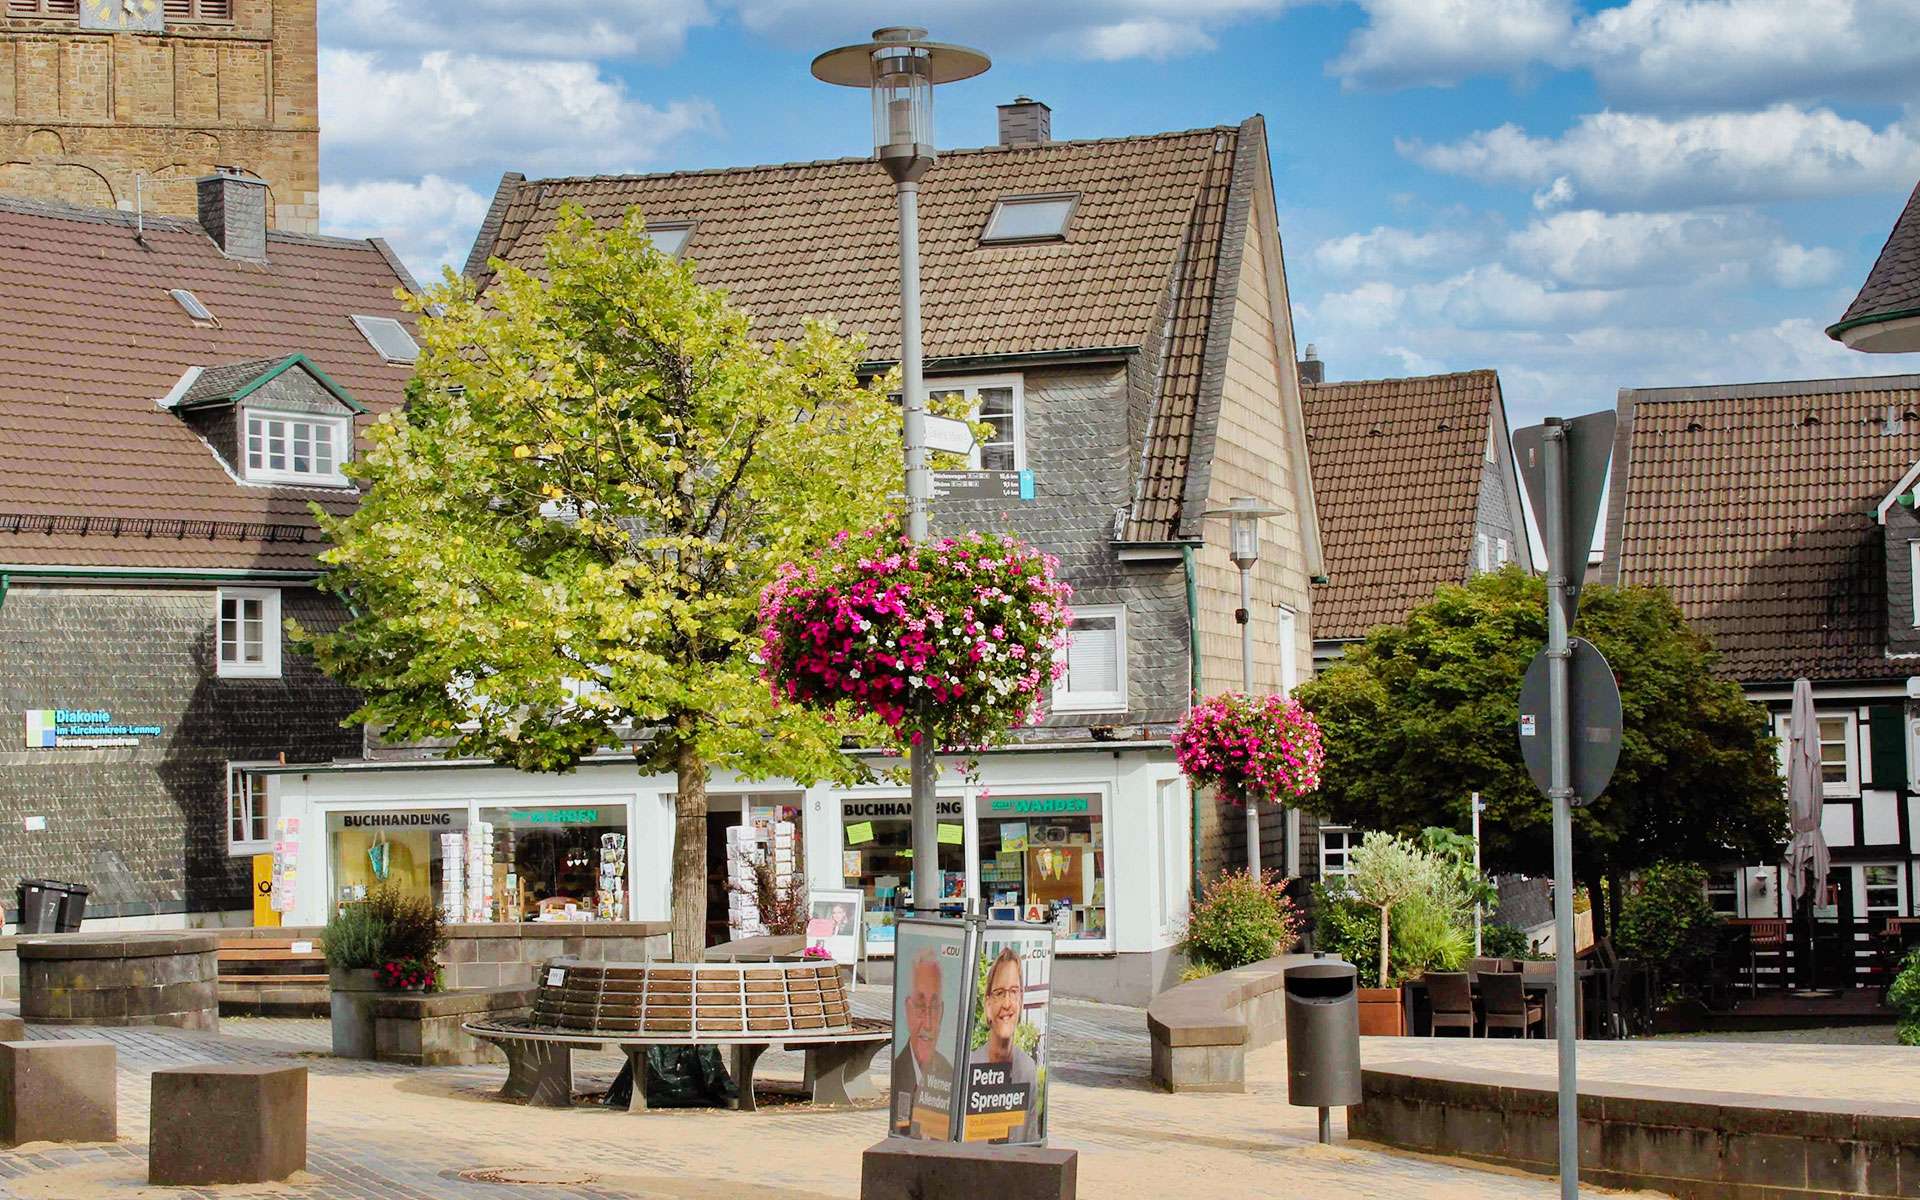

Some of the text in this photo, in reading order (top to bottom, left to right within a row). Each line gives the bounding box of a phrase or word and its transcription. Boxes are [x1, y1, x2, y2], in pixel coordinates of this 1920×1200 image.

[56, 710, 111, 723] Diakonie
[70, 726, 127, 735] Kirchenkreis
[129, 726, 161, 736] Lennep
[814, 801, 822, 811] 8
[844, 802, 962, 816] BUCHHANNG
[344, 813, 451, 827] BUCHHANDLUNG
[946, 946, 960, 957] CDU
[1031, 949, 1046, 959] CDU
[973, 1069, 1005, 1086] Petra
[971, 1091, 1025, 1113] Sprenger
